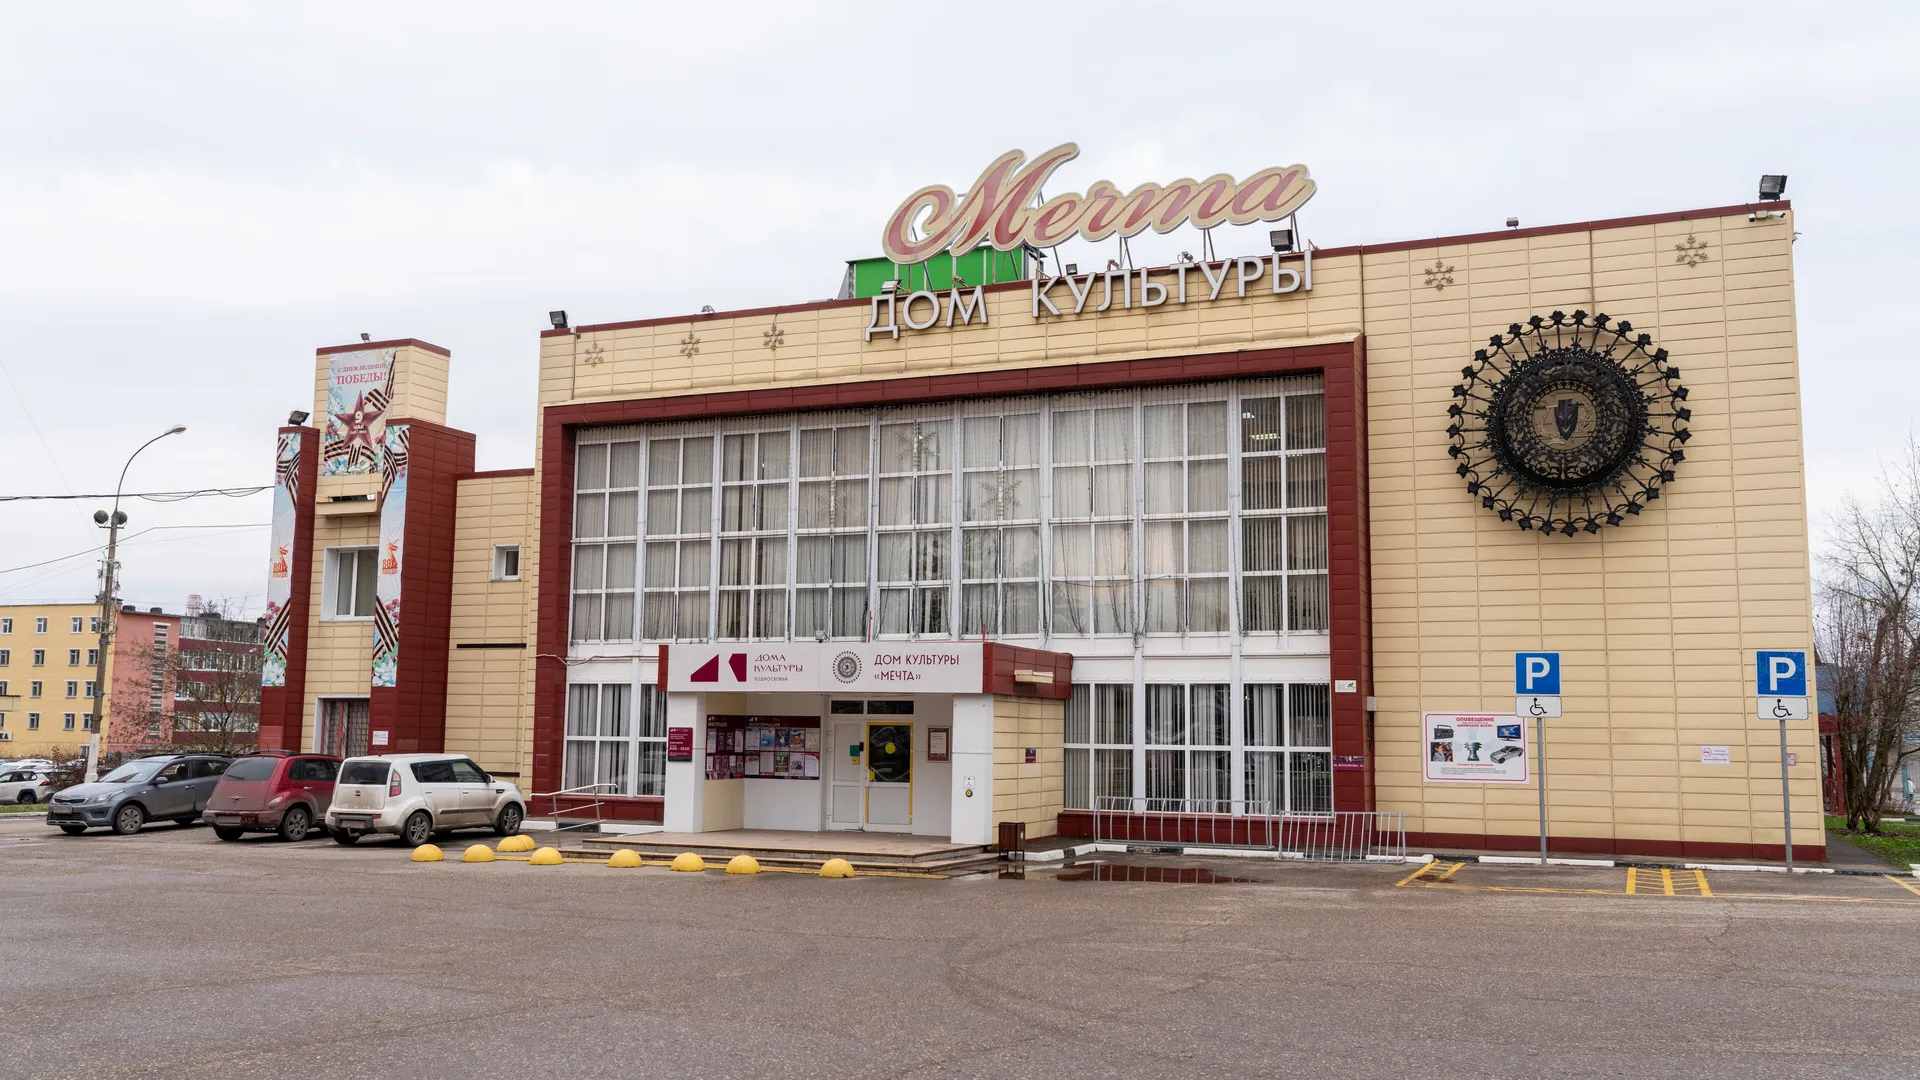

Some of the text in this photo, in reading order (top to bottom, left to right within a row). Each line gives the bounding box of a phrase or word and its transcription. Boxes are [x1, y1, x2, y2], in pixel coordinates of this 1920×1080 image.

[883, 141, 1317, 265] Мечта
[864, 249, 1313, 342] ДОМ КУЛЬТУРЫ
[336, 372, 387, 385] ПОБЕДЫ!
[354, 410, 364, 424] 9
[754, 653, 786, 662] ДОМА
[873, 654, 960, 666] ДОМ КУЛЬТУРЫ
[754, 664, 803, 673] КУЛЬТУРЫ
[1526, 657, 1550, 690] P
[1769, 657, 1796, 691] P
[874, 670, 921, 681] «МЕЧТА»
